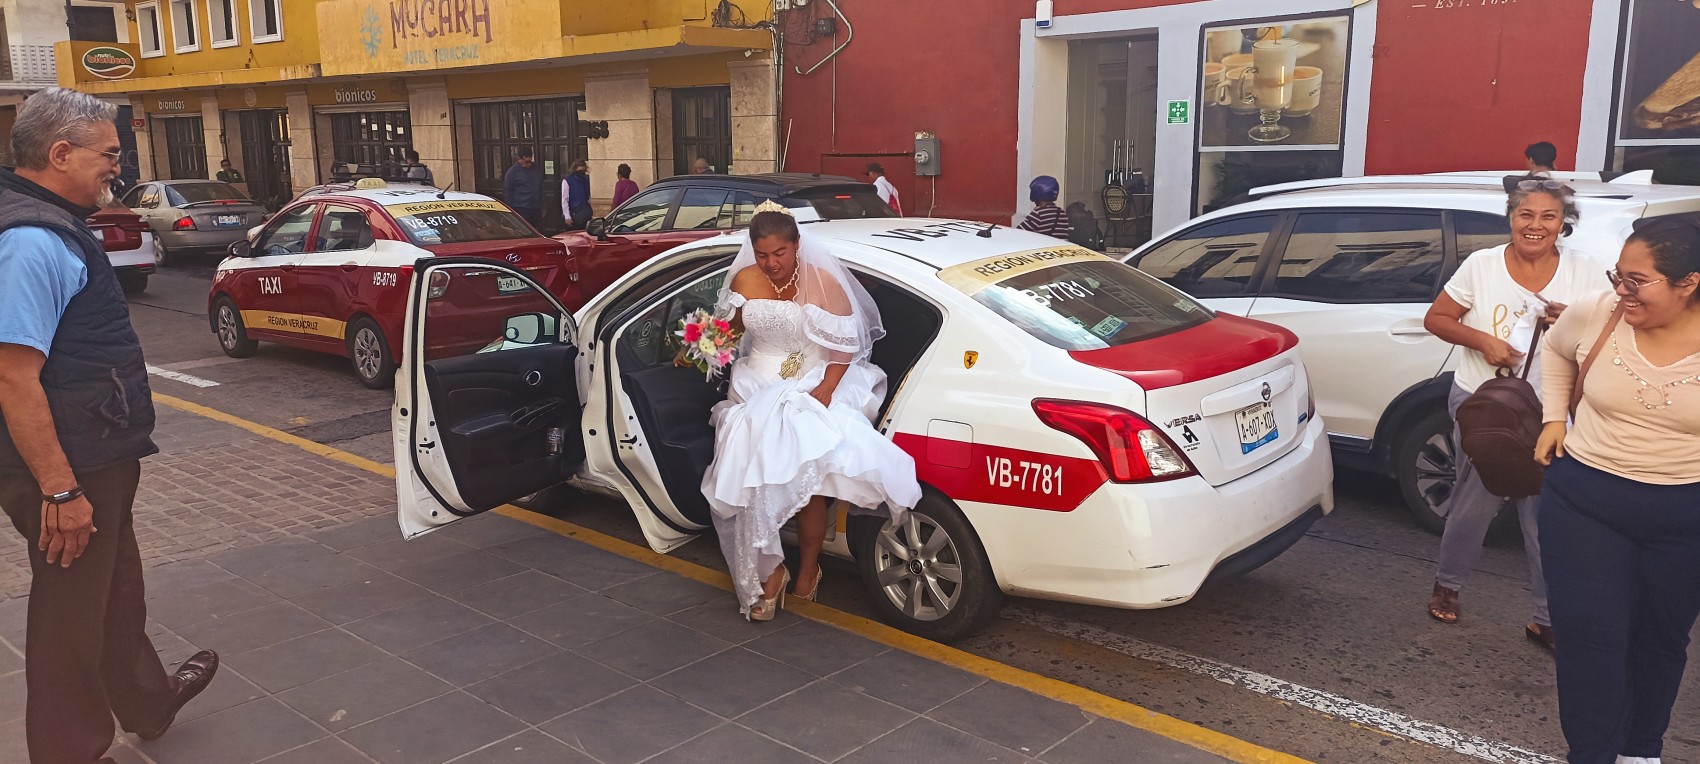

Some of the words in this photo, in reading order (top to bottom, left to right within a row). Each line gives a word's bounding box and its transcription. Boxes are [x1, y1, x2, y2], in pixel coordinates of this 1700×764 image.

[404, 50, 428, 65] HOTEL
[335, 86, 376, 103] bionicos
[158, 99, 185, 110] bionicos
[446, 201, 495, 210] VERACRUZ
[406, 215, 458, 230] VB-8719
[1027, 248, 1096, 264] VERACRUZ
[258, 276, 282, 294] TAXI
[373, 271, 397, 287] VB-8719
[268, 316, 289, 327] REGION
[288, 318, 319, 331] VERACRUZ
[1163, 413, 1202, 429] VERSA
[986, 455, 1062, 496] VB-7781
